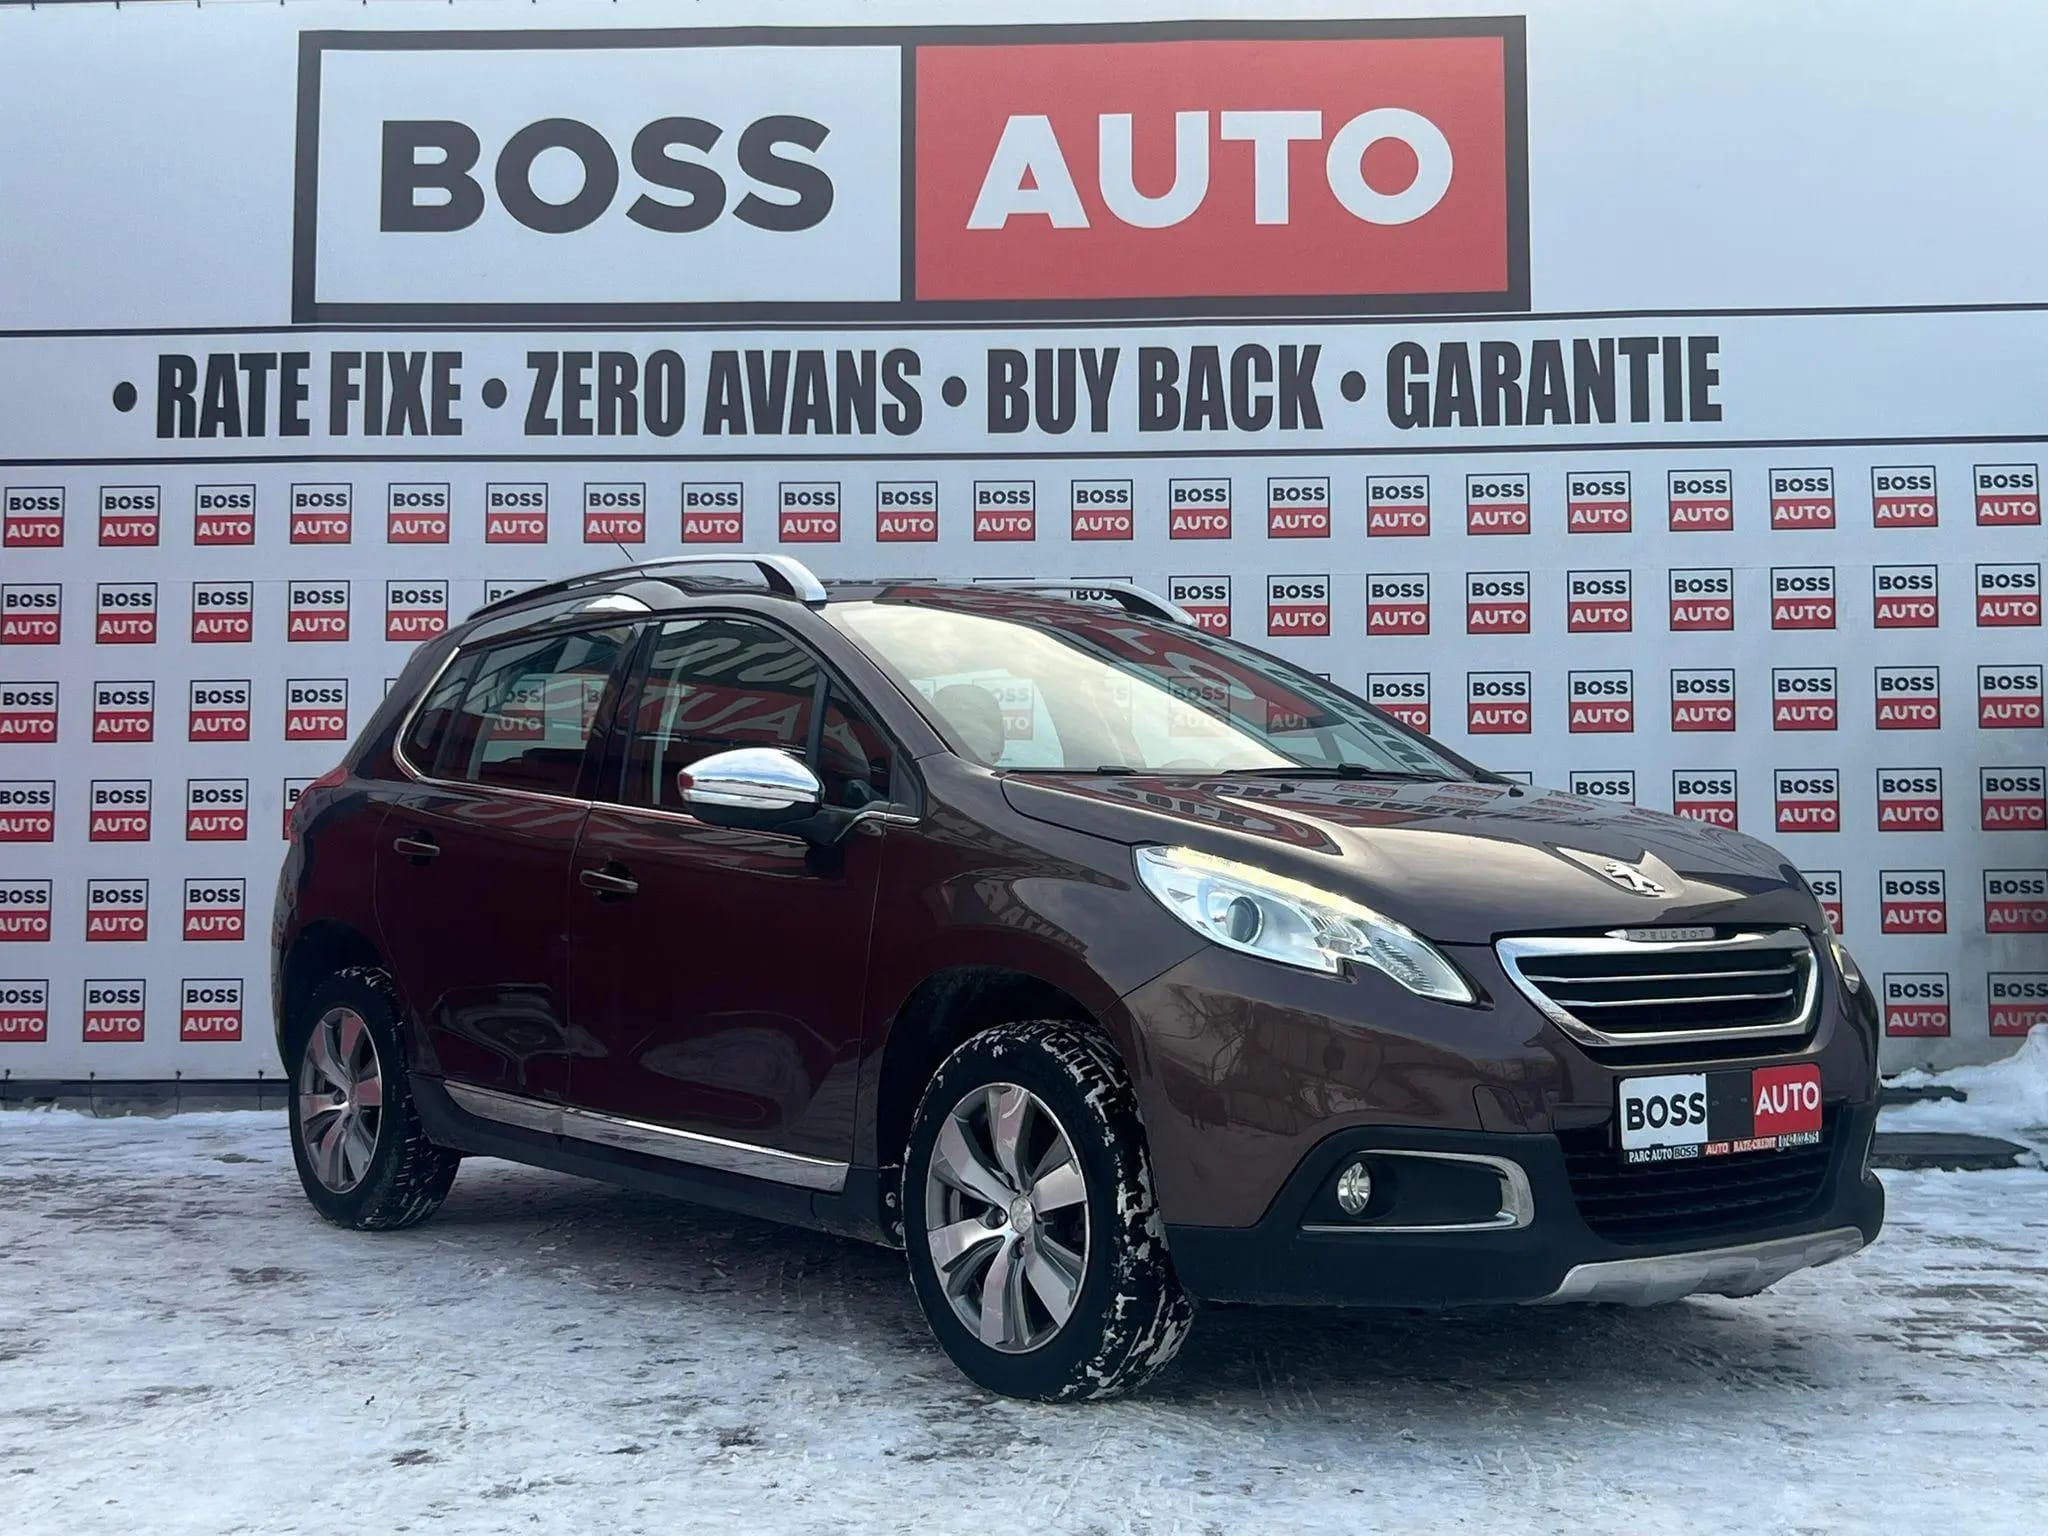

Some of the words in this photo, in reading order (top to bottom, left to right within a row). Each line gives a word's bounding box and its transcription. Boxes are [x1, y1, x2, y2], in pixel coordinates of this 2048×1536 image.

[380, 115, 834, 234] BOSS
[966, 107, 1454, 230] AUTO
[156, 351, 311, 439] RATE
[329, 351, 463, 436] FIXE
[524, 349, 686, 438] ZERO
[702, 348, 923, 436] AVANS
[987, 347, 1121, 435] BUY
[1138, 343, 1324, 433] BACK
[1385, 335, 1723, 430] GARANTIE
[1673, 479, 1727, 495] BOSS
[1774, 478, 1829, 492] BOSS
[1877, 476, 1932, 490] BOSS
[1979, 473, 2034, 489] BOSS
[1076, 489, 1129, 504] BOSS
[1174, 487, 1227, 503] BOSS
[1272, 486, 1326, 502] BOSS
[1371, 485, 1425, 500] BOSS
[1471, 483, 1525, 499] BOSS
[1572, 481, 1626, 497] BOSS
[9, 496, 60, 511] BOSS
[104, 495, 155, 510] BOSS
[200, 494, 251, 509] BOSS
[295, 493, 348, 508] BOSS
[393, 492, 445, 507] BOSS
[491, 492, 543, 507] BOSS
[589, 492, 641, 507] BOSS
[686, 492, 738, 507] BOSS
[784, 491, 836, 506] BOSS
[881, 491, 934, 505] BOSS
[978, 490, 1031, 505] BOSS
[1572, 508, 1628, 524] AUTO
[1674, 507, 1729, 522] AUTO
[1774, 506, 1832, 520] AUTO
[1877, 504, 1934, 518] AUTO
[1981, 501, 2037, 517] AUTO
[880, 518, 935, 533] AUTO
[978, 517, 1032, 532] AUTO
[1076, 516, 1130, 531] AUTO
[1174, 515, 1228, 530] AUTO
[1272, 514, 1327, 529] AUTO
[1373, 512, 1426, 527] AUTO
[1471, 510, 1526, 526] AUTO
[7, 523, 60, 538] AUTO
[103, 522, 155, 537] AUTO
[198, 521, 252, 536] AUTO
[294, 520, 348, 535] AUTO
[392, 520, 446, 534] AUTO
[490, 520, 544, 534] AUTO
[588, 519, 642, 534] AUTO
[686, 519, 739, 534] AUTO
[783, 519, 837, 533] AUTO
[1572, 580, 1627, 595] BOSS
[1674, 578, 1729, 594] BOSS
[1776, 576, 1830, 592] BOSS
[1878, 575, 1933, 590] BOSS
[1981, 573, 2036, 589] BOSS
[391, 589, 444, 604] BOSS
[1076, 590, 1114, 601] BOS
[1174, 585, 1227, 600] BOSS
[1272, 584, 1325, 599] BOSS
[1371, 583, 1425, 598] BOSS
[1471, 581, 1525, 597] BOSS
[6, 593, 57, 608] BOSS
[101, 592, 153, 607] BOSS
[197, 591, 249, 606] BOSS
[293, 590, 345, 605] BOSS
[1572, 608, 1628, 623] AUTO
[1674, 606, 1730, 621] AUTO
[1776, 604, 1832, 620] AUTO
[1879, 603, 1935, 619] AUTO
[1980, 601, 2038, 617] AUTO
[390, 617, 444, 632] AUTO
[1194, 613, 1228, 628] TO
[1272, 612, 1327, 627] AUTO
[1371, 611, 1426, 626] AUTO
[1471, 609, 1527, 625] AUTO
[3, 621, 57, 635] AUTO
[99, 620, 153, 635] AUTO
[196, 618, 249, 634] AUTO
[291, 617, 346, 633] AUTO
[1472, 681, 1526, 697] BOSS
[1573, 680, 1628, 695] BOSS
[1676, 679, 1730, 694] BOSS
[1777, 677, 1833, 693] BOSS
[1880, 677, 1935, 692] BOSS
[1983, 675, 2038, 690] BOSS
[98, 690, 150, 705] BOSS
[195, 689, 246, 705] BOSS
[291, 688, 343, 703] BOSS
[505, 688, 542, 703] OSS
[1371, 683, 1426, 698] BOSS
[2, 691, 54, 706] BOSS
[1394, 710, 1427, 725] TO
[1473, 709, 1527, 725] AUTO
[1574, 708, 1630, 724] AUTO
[1675, 707, 1732, 722] AUTO
[1777, 706, 1834, 721] AUTO
[1879, 705, 1937, 720] AUTO
[1983, 703, 2040, 719] AUTO
[0, 719, 54, 734] AUTO
[97, 718, 150, 733] AUTO
[193, 717, 247, 732] AUTO
[289, 716, 343, 731] AUTO
[1003, 714, 1030, 730] TO
[1270, 713, 1306, 729] AUT
[1575, 781, 1631, 796] BOSS
[1678, 780, 1733, 795] BOSS
[1780, 779, 1835, 794] BOSS
[1882, 779, 1937, 793] BOSS
[1986, 777, 2041, 792] BOSS
[0, 790, 51, 805] BOSS
[95, 789, 147, 804] BOSS
[191, 788, 244, 804] BOSS
[1680, 808, 1735, 823] AUTO
[1781, 807, 1836, 823] AUTO
[1881, 807, 1939, 822] AUTO
[1985, 805, 2043, 820] AUTO
[0, 818, 51, 833] AUTO
[93, 817, 147, 832] AUTO
[189, 816, 244, 831] AUTO
[1813, 881, 1837, 896] SS
[1885, 880, 1941, 895] BOSS
[1989, 880, 2044, 895] BOSS
[92, 889, 144, 904] BOSS
[189, 888, 241, 903] BOSS
[1886, 909, 1941, 924] AUTO
[1989, 908, 2048, 923] AUTO
[90, 917, 144, 932] AUTO
[187, 916, 241, 931] AUTO
[1639, 929, 1706, 941] PEUGEOT
[0, 989, 44, 1004] OSS
[89, 989, 141, 1004] BOSS
[186, 988, 238, 1004] BOSS
[1889, 982, 1945, 998] BOSS
[1993, 983, 2048, 998] BOSS
[0, 1017, 43, 1032] UTO
[87, 1017, 141, 1032] AUTO
[184, 1016, 238, 1032] AUTO
[1888, 1011, 1947, 1027] AUTO
[1625, 1092, 1706, 1131] BOSS
[1755, 1081, 1820, 1116] AUTO
[1628, 1150, 1650, 1163] PARC
[1651, 1148, 1673, 1161] AUTO
[1674, 1146, 1698, 1158] BOSS
[1705, 1142, 1729, 1155] AUTO
